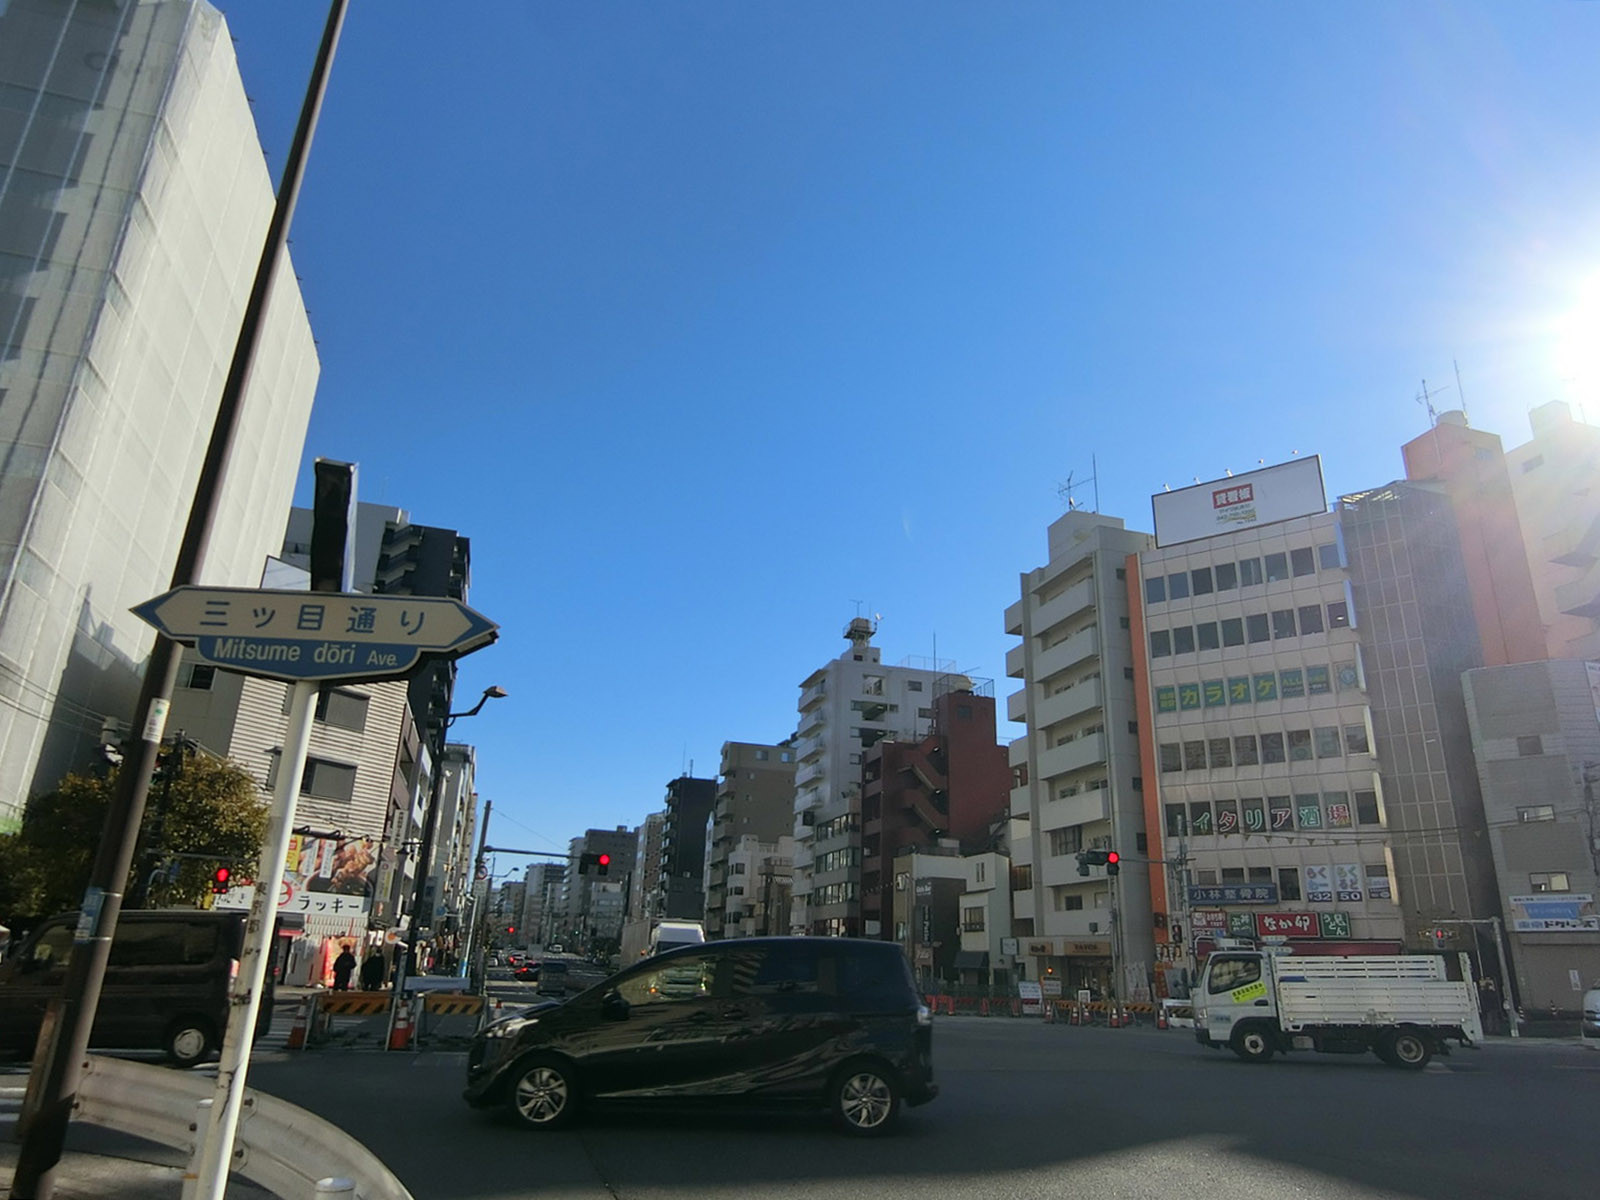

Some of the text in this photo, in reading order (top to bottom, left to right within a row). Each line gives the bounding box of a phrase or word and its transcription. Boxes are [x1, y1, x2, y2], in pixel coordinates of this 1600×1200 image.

[200, 600, 425, 636] 三ツ目通り
[213, 637, 301, 662] Mitsume
[313, 642, 355, 664] dōri
[1181, 678, 1274, 705] カラオケ
[1193, 803, 1350, 832] イタリア酒場
[298, 893, 359, 914] ラッキー
[1263, 915, 1310, 931] なか卯
